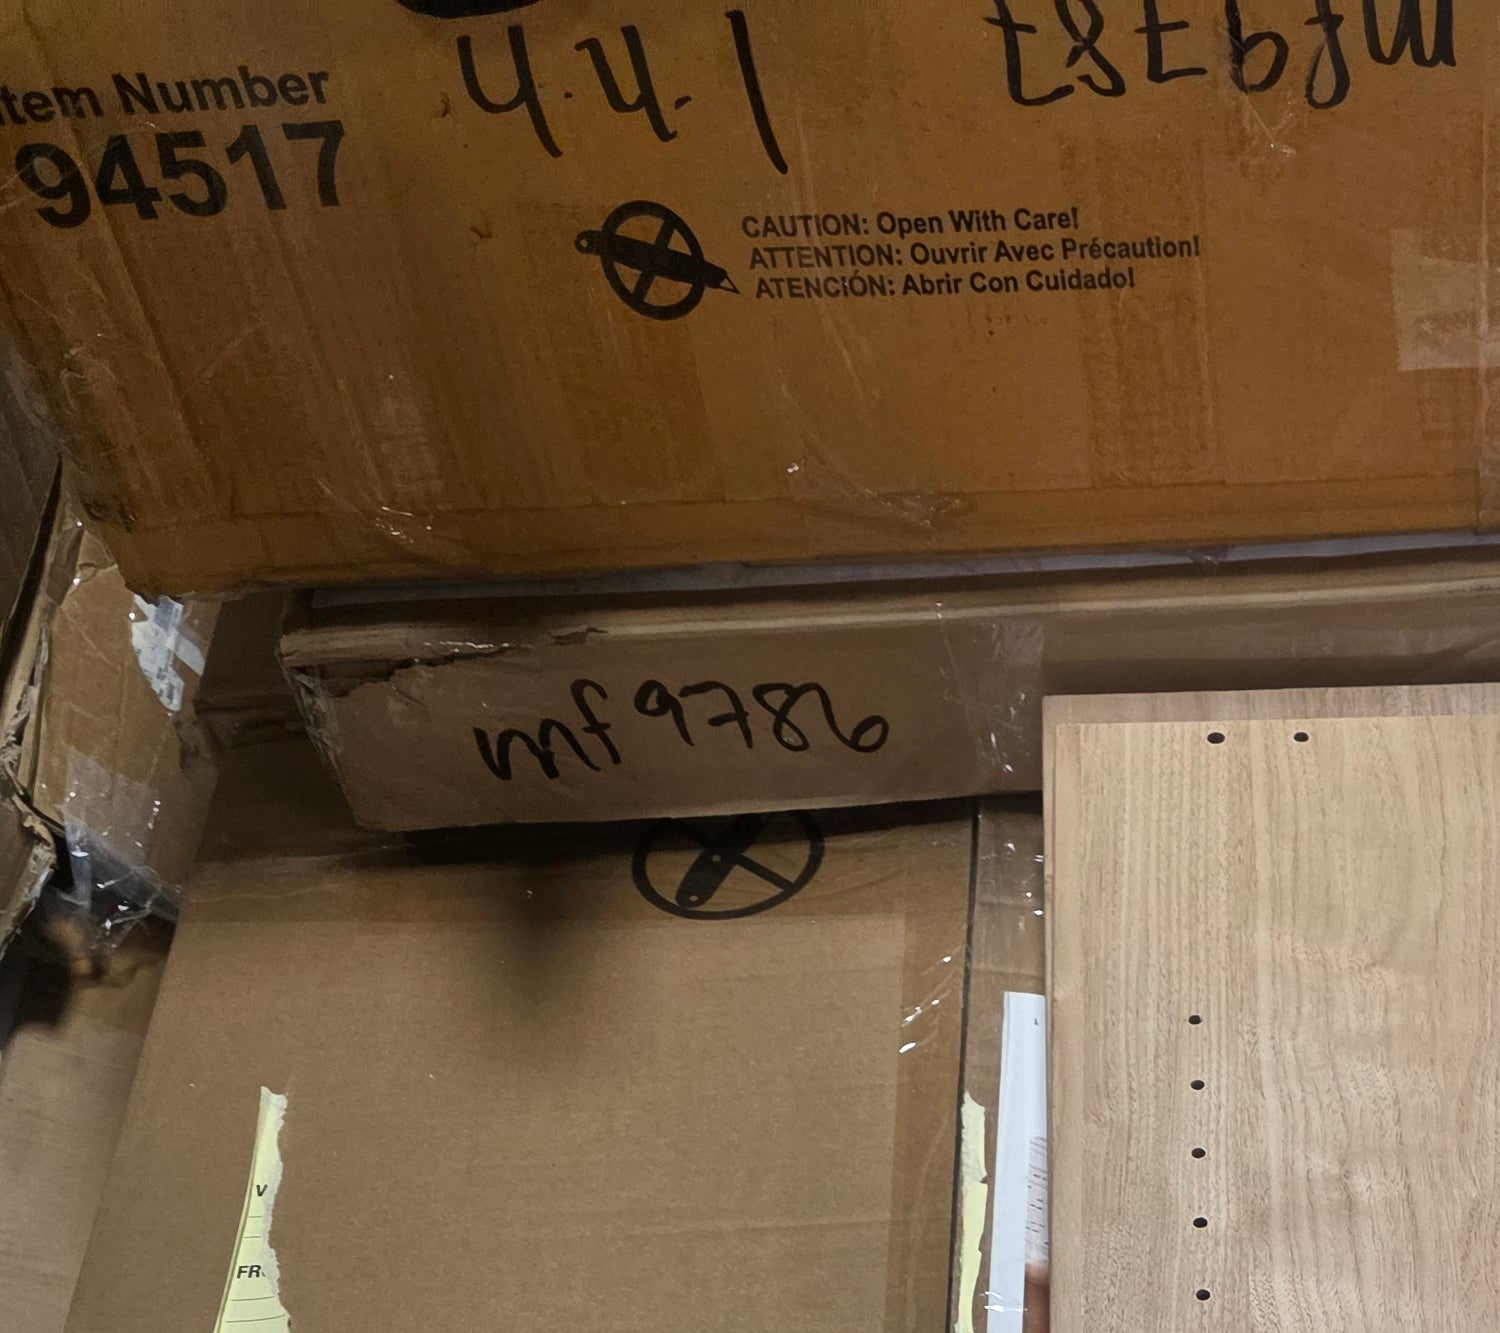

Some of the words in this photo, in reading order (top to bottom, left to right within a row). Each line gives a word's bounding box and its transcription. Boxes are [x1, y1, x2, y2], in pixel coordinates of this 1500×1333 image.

[0, 85, 104, 127] tem
[111, 65, 329, 115] Number
[15, 120, 345, 229] 94517
[741, 214, 869, 238] CAUTION:
[877, 211, 944, 238] Open
[947, 208, 1006, 233] With
[1014, 207, 1079, 231] Care!
[749, 244, 903, 270] ATTENTION:
[910, 240, 987, 265] Ouvrir
[994, 238, 1055, 262] Avec
[1062, 235, 1201, 260] Précaution!
[755, 271, 895, 299] ATENCIÓN:
[902, 269, 960, 295] Abrir
[969, 272, 1018, 293] Con
[1025, 267, 1135, 291] Cuidado!
